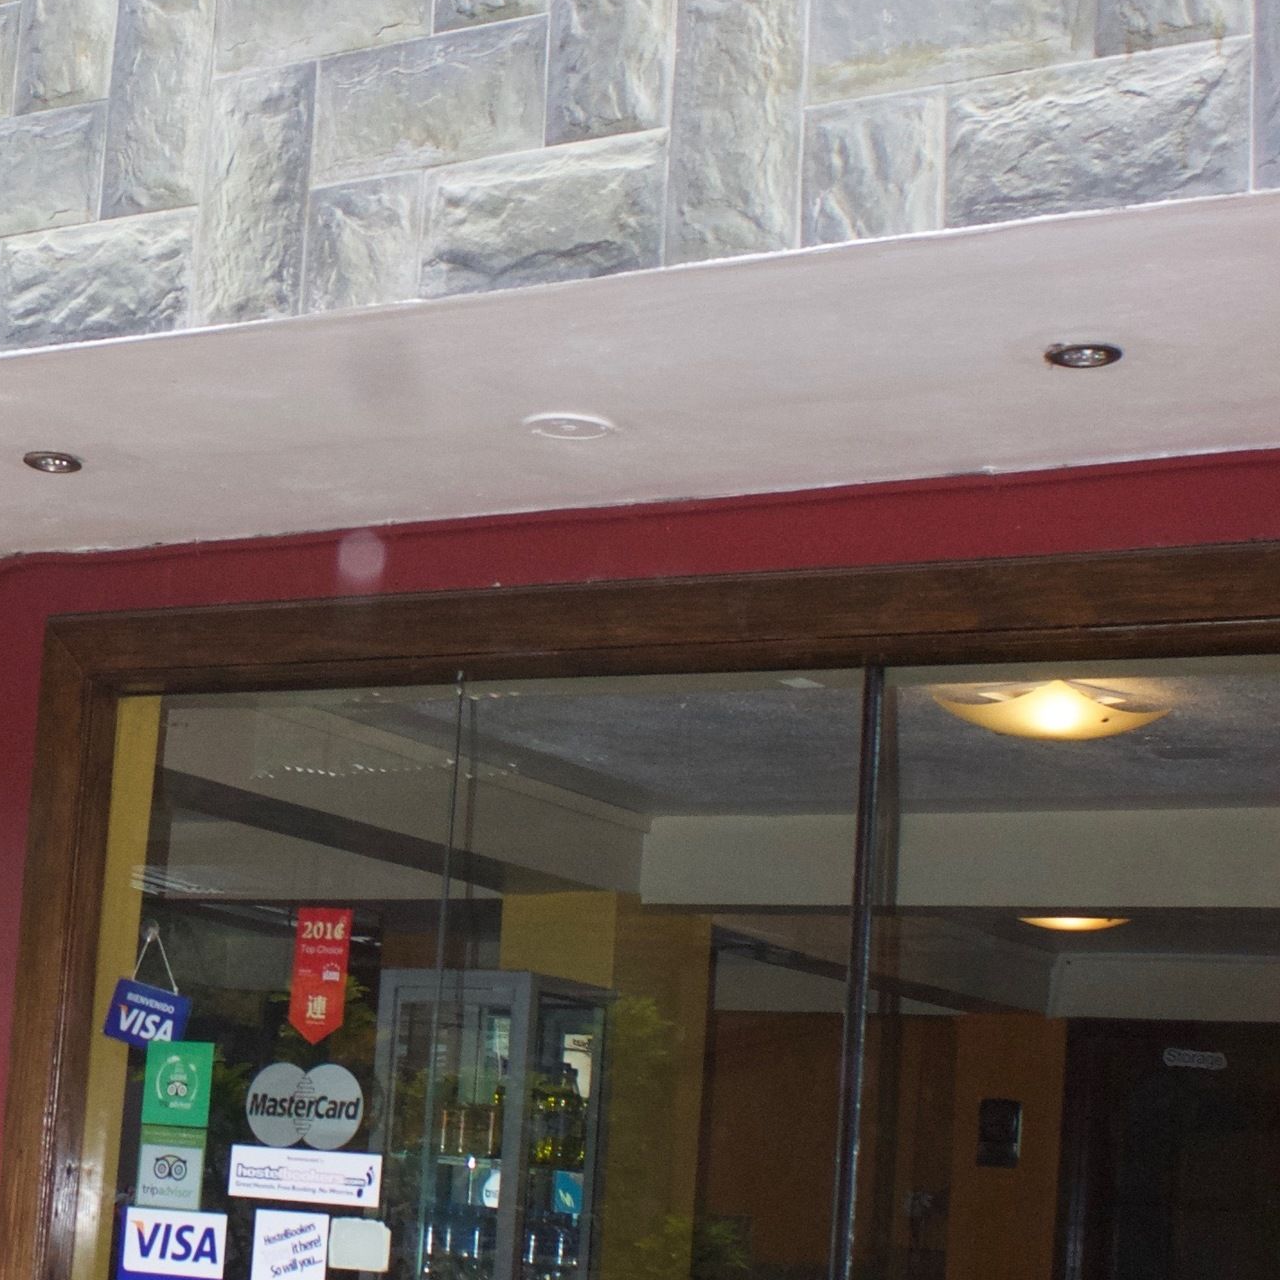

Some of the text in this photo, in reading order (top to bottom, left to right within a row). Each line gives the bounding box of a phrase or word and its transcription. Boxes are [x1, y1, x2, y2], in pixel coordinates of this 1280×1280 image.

[126, 992, 175, 1014] BIENVENIDO
[118, 1004, 174, 1041] VISA
[1167, 1050, 1224, 1069] Storage
[248, 1093, 361, 1120] MasterCard
[142, 1185, 193, 1198] tripadvisor
[131, 1220, 217, 1264] VISA
[291, 1236, 322, 1255] it here!
[270, 1265, 282, 1278] So
[283, 1259, 298, 1274] will
